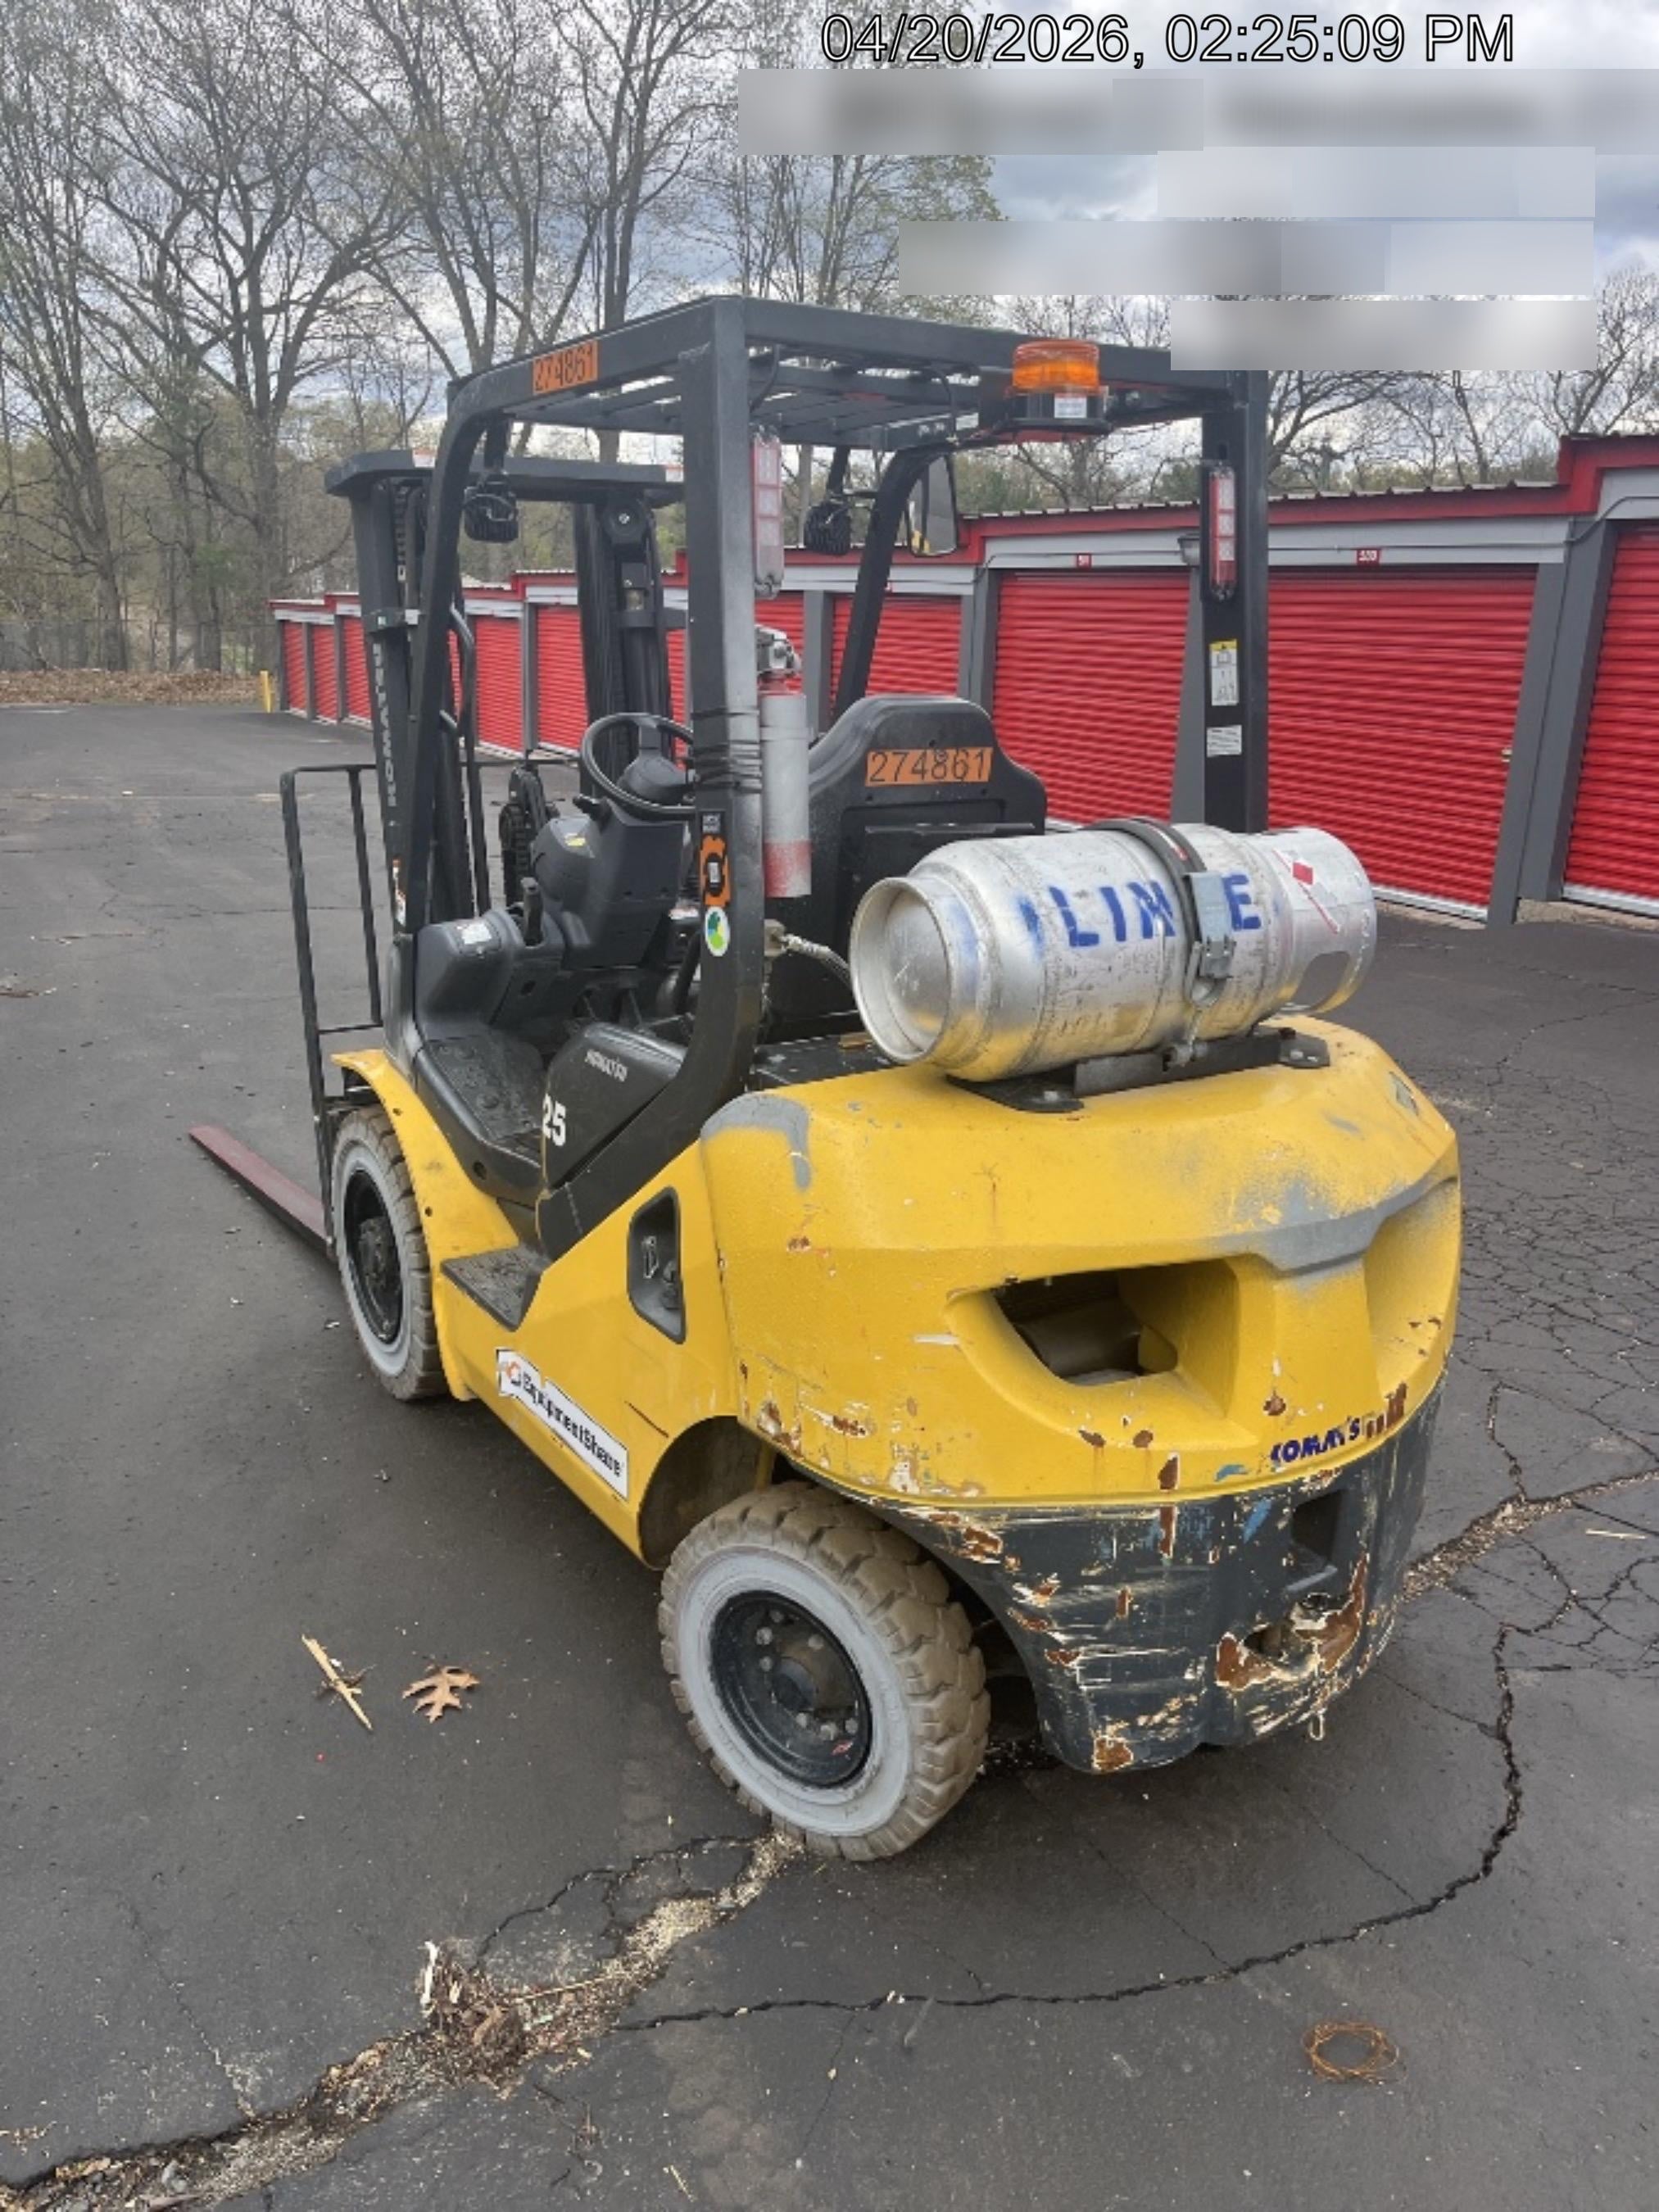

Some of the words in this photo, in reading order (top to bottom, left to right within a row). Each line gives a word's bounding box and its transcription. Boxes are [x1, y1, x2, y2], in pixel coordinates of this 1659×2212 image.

[534, 342, 593, 392] 274861
[868, 748, 986, 782] 274861
[542, 1092, 567, 1147] 25
